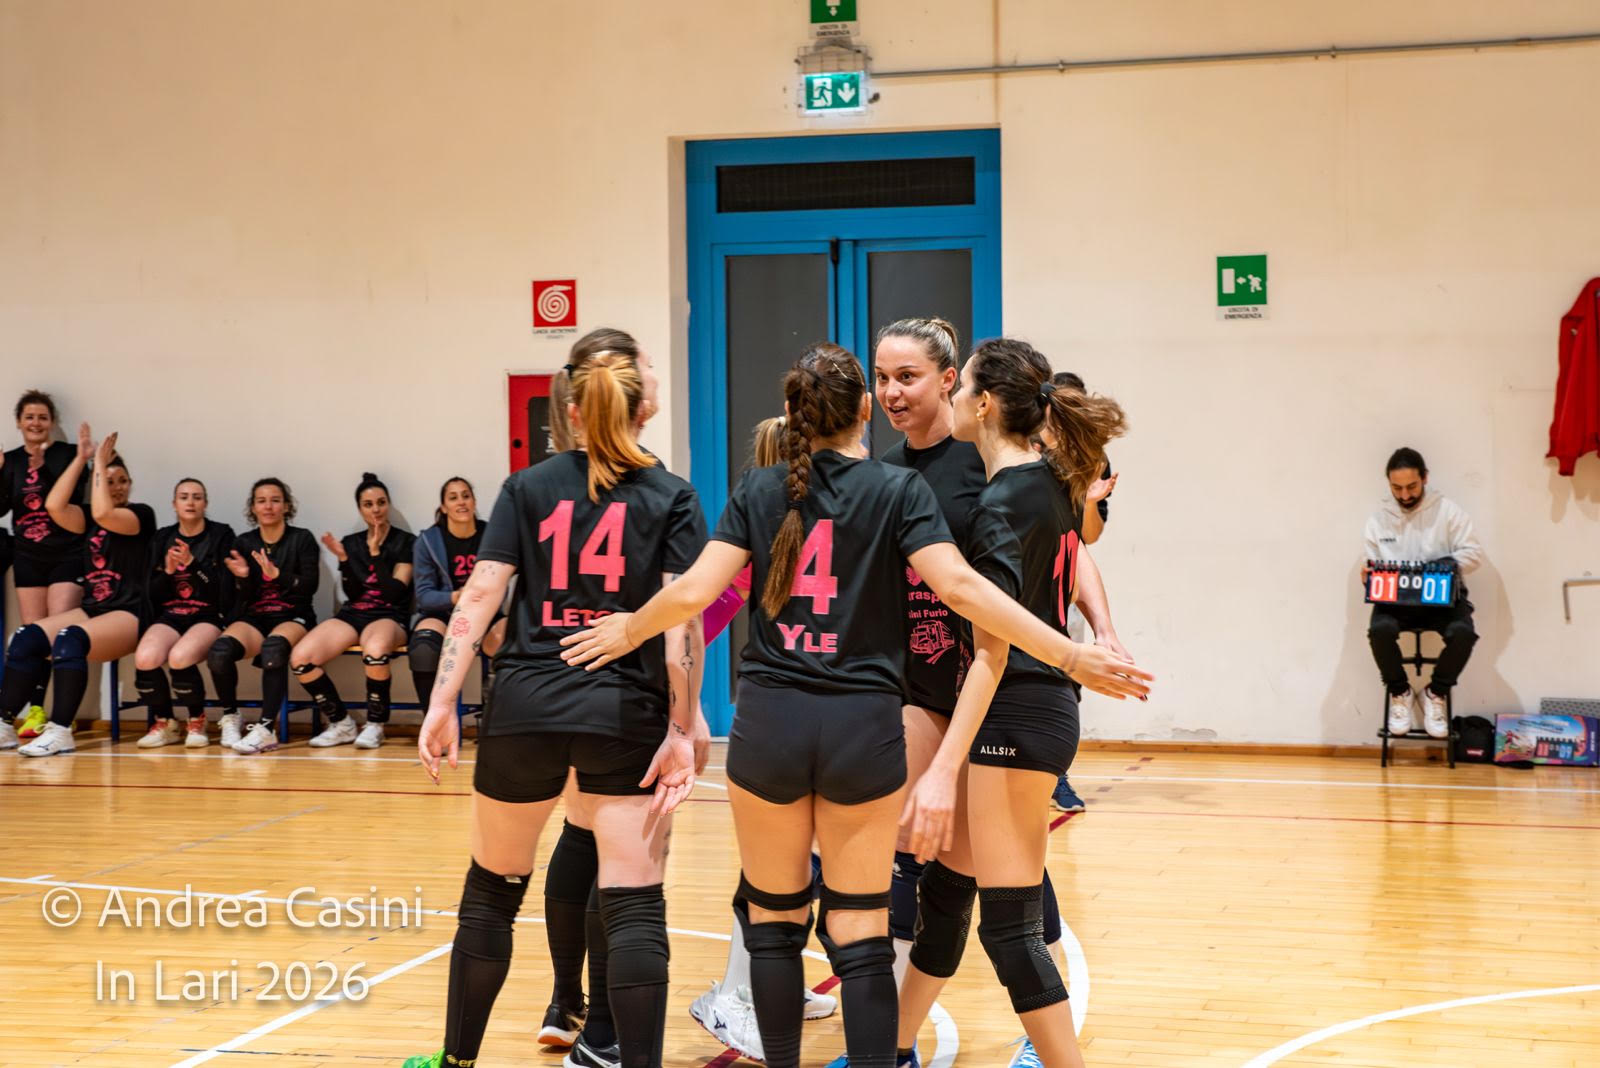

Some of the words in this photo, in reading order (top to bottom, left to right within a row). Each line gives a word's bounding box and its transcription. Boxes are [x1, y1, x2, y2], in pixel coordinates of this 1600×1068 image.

[538, 500, 627, 592] 14
[790, 519, 837, 614] 4
[1371, 575, 1396, 599] 01
[1423, 577, 1448, 602] 01
[923, 608, 948, 618] Furio
[776, 623, 838, 653] YLE
[980, 745, 1016, 757] ALLSIX
